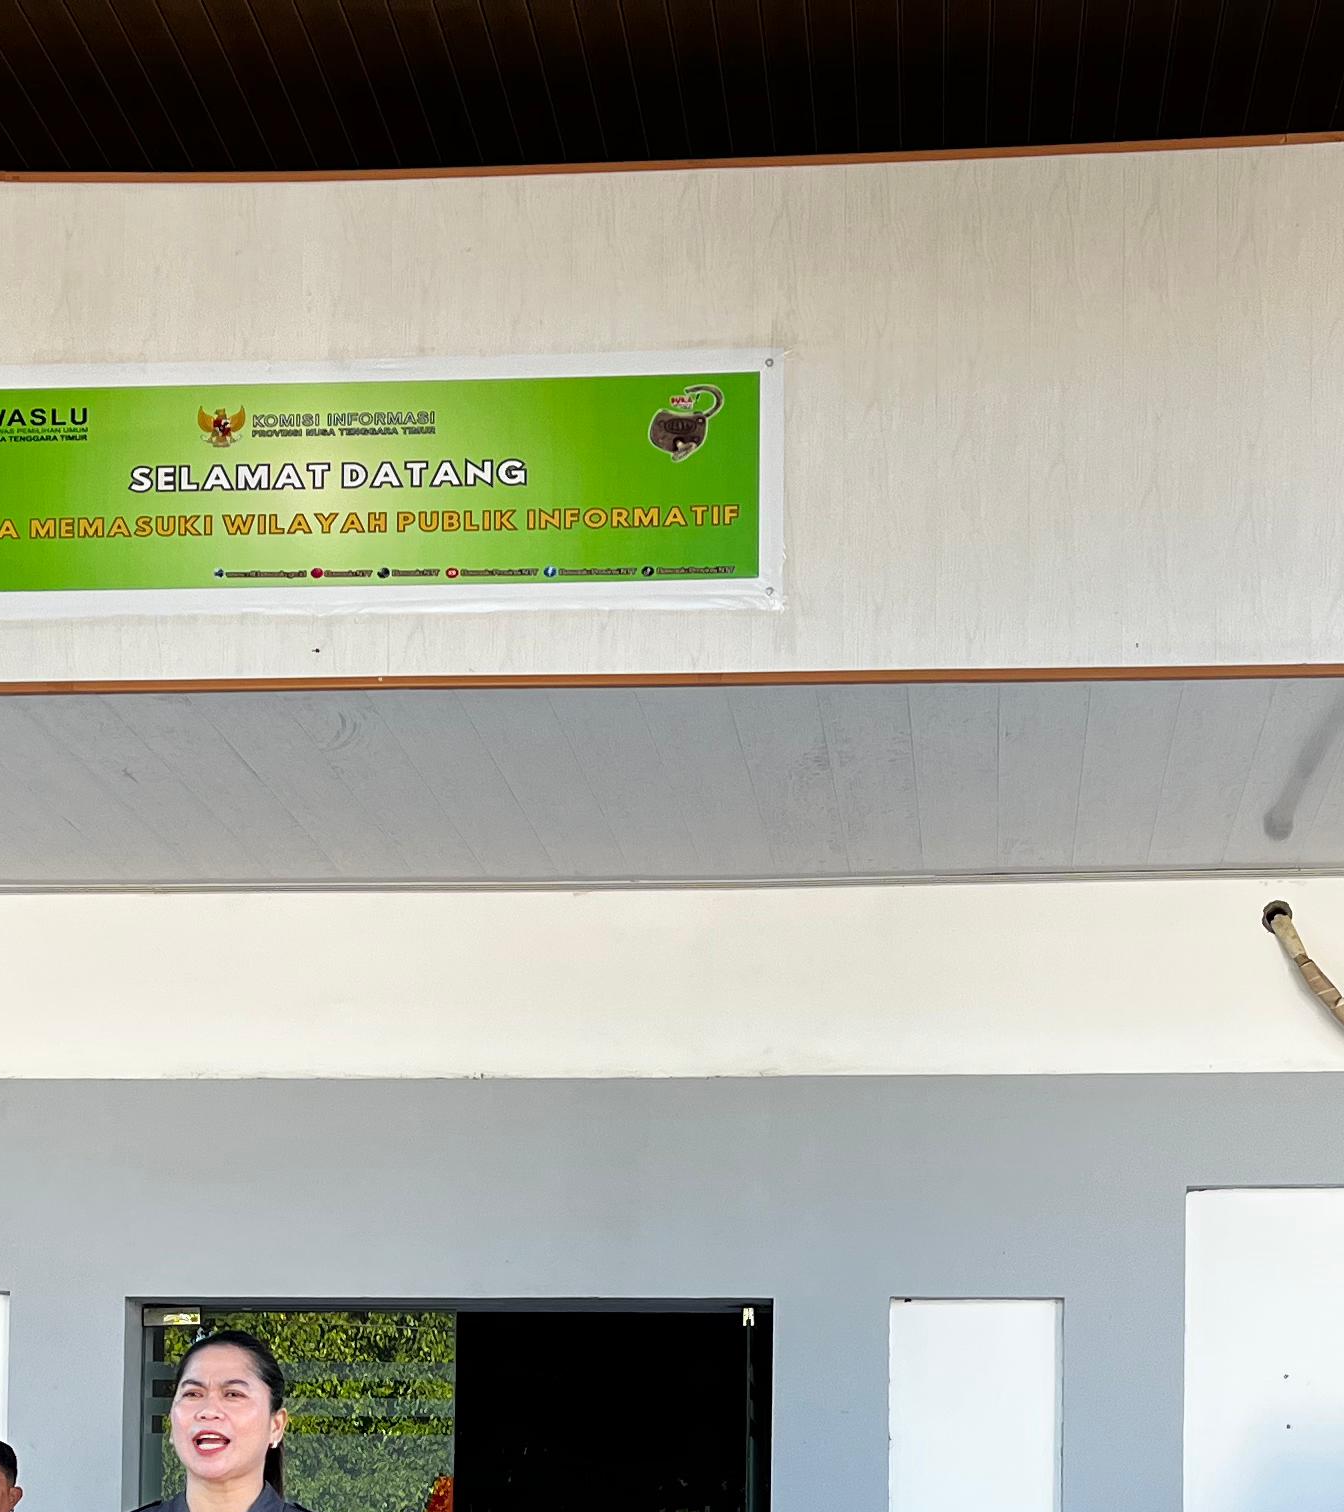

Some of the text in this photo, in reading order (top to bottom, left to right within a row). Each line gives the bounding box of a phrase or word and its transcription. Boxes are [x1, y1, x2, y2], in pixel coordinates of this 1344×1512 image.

[252, 410, 435, 428] KOMISI INFORMASI
[8, 435, 59, 443] TENGGARA
[61, 434, 88, 442] TIMUR
[128, 458, 528, 493] SELAMAT DATANG
[29, 514, 212, 540] MEMASUKI
[222, 511, 388, 536] WILAYAH
[396, 508, 519, 533] PUBLIK
[526, 504, 740, 531] INFORMATIF
